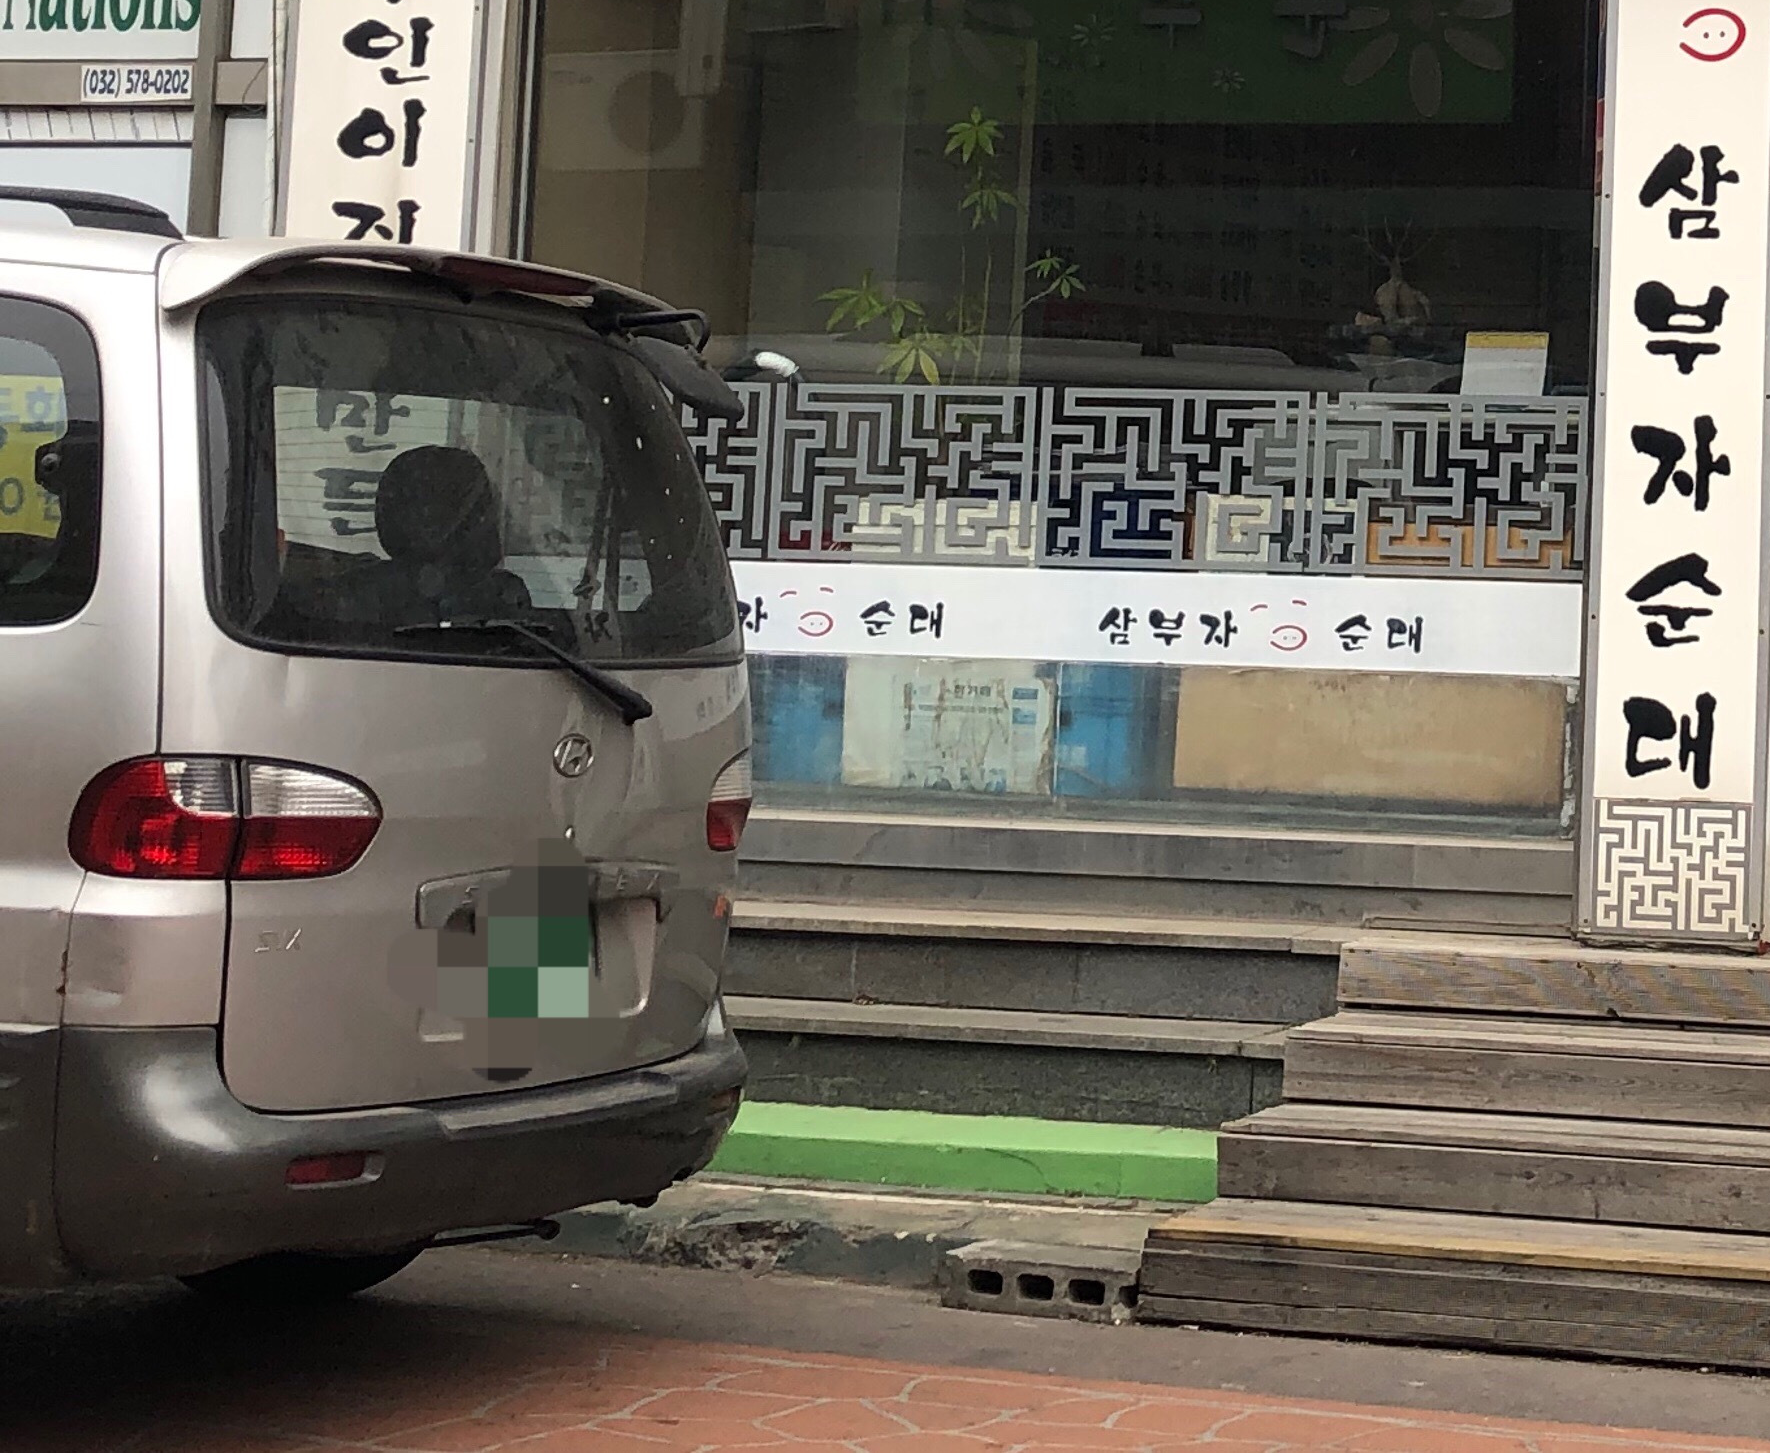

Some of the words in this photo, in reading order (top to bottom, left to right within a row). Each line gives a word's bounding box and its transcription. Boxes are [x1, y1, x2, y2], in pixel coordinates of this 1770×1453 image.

[83, 67, 121, 98] (032)
[124, 65, 189, 96] 578-0202
[1623, 143, 1739, 790] 삼부자순대
[859, 600, 945, 639] 순대
[1098, 607, 1239, 648] 삼부자
[1334, 614, 1424, 654] 순대
